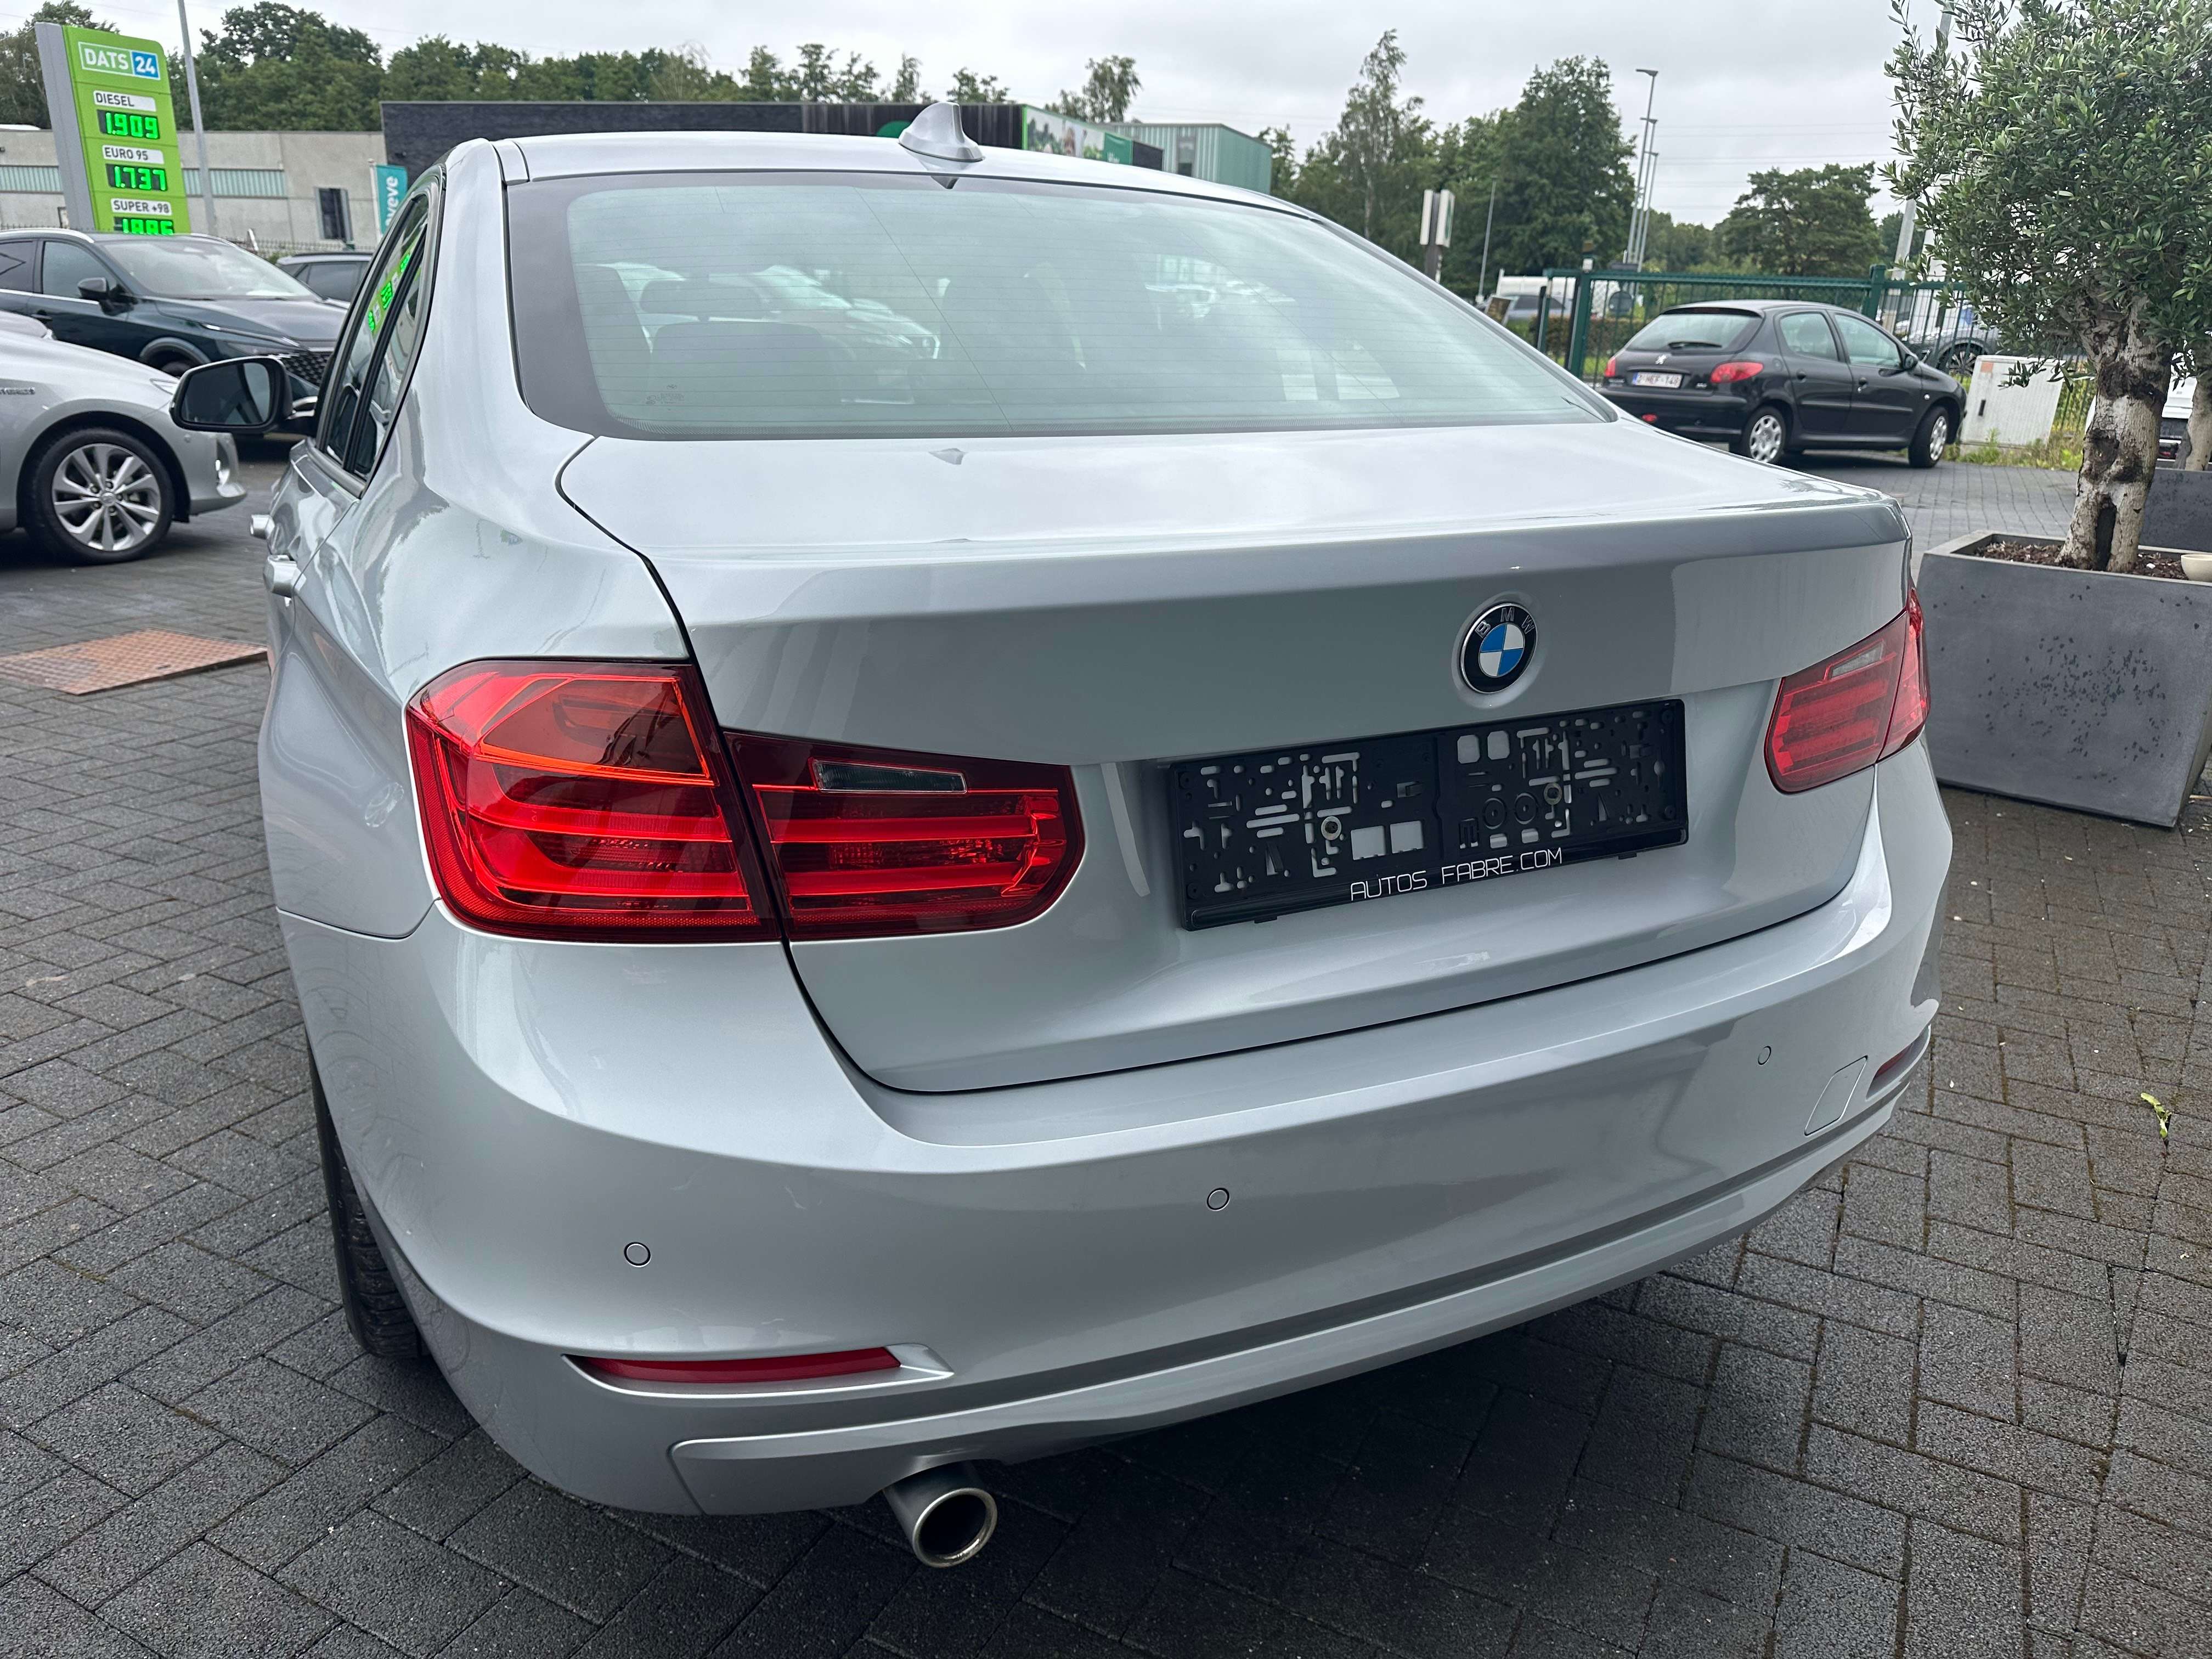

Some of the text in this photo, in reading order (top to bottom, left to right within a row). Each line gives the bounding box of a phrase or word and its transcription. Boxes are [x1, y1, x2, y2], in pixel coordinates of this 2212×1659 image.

[84, 48, 156, 75] DATS 24
[95, 93, 134, 107] DIESEL
[104, 147, 148, 161] EURO 95
[114, 166, 166, 191] 1.737
[114, 200, 170, 213] SUPER +98
[1474, 607, 1535, 639] BMW
[1350, 847, 1562, 901] AUTOS FABRE.COM
